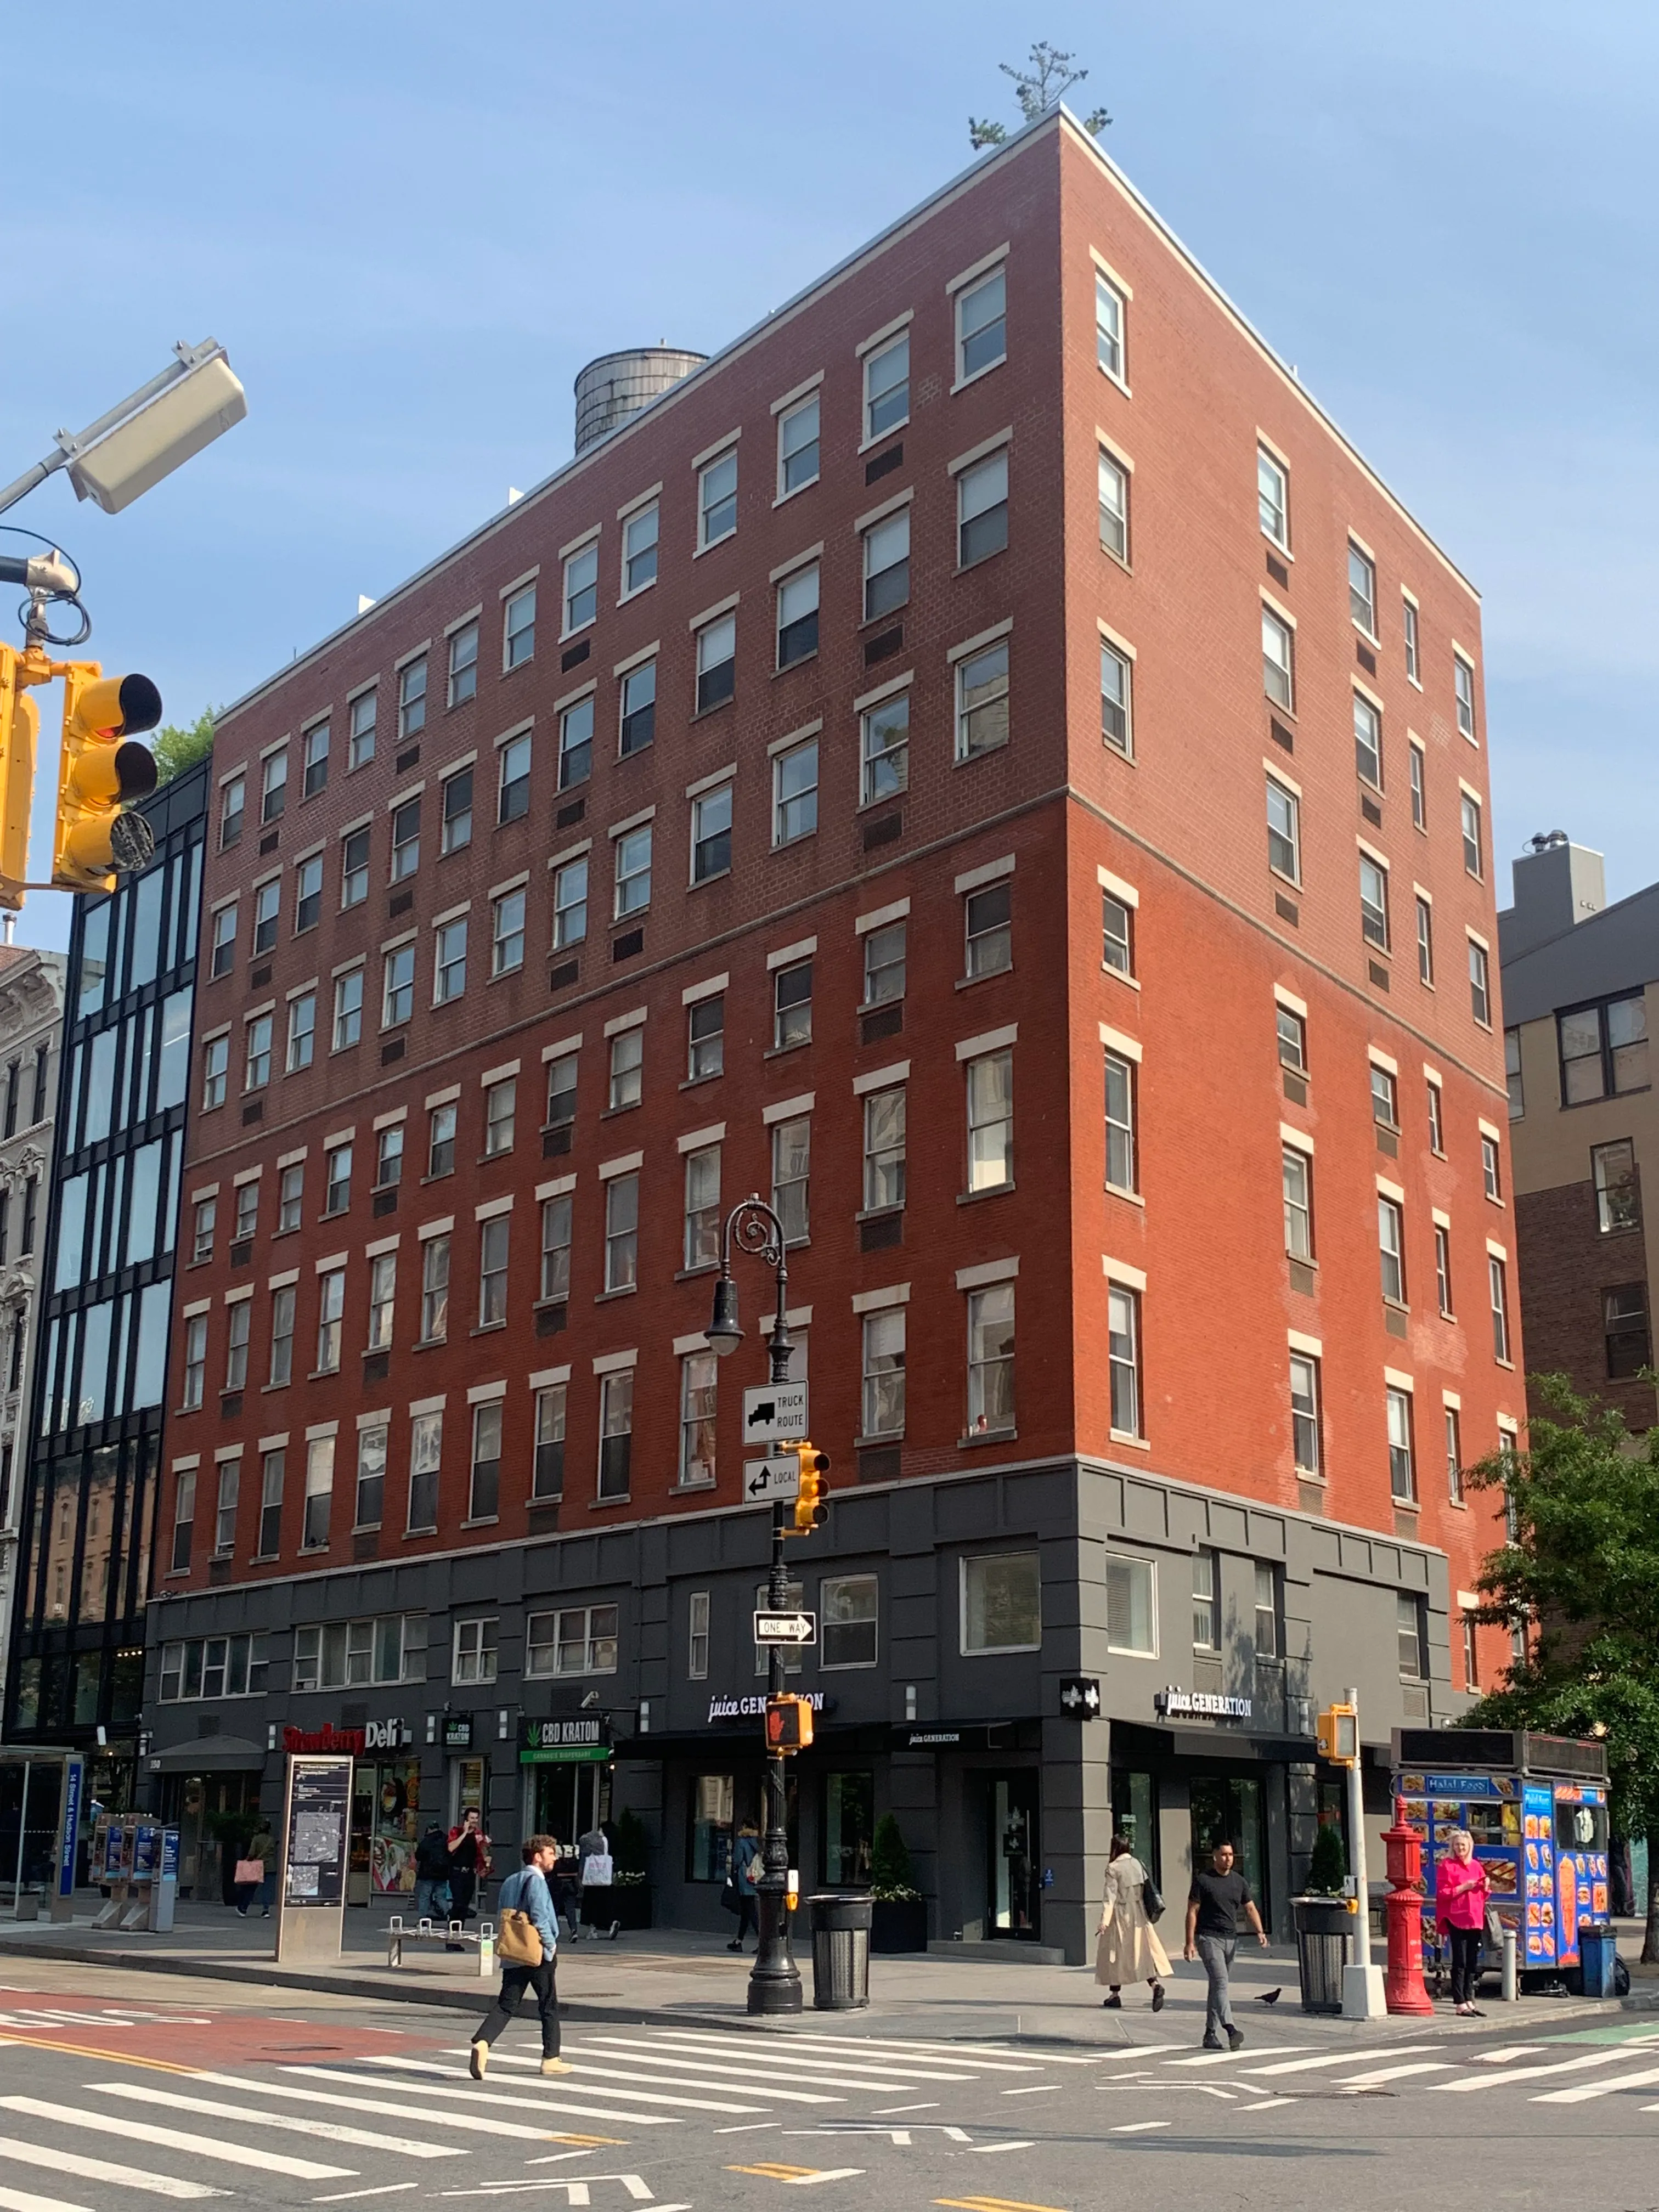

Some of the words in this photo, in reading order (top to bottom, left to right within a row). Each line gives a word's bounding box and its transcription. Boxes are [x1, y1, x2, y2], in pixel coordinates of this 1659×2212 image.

[777, 1395, 804, 1408] TRUCK
[777, 1414, 803, 1427] ROUTE
[774, 1471, 796, 1484] LOCAL
[764, 1622, 781, 1633] ONE
[789, 1622, 806, 1634] WAY
[1167, 1685, 1192, 1716] juice
[1192, 1692, 1252, 1717] GENERATION
[708, 1694, 740, 1723] juice
[365, 1718, 400, 1748] Deli
[458, 1724, 470, 1732] CBD
[542, 1723, 560, 1743] CBD
[562, 1720, 600, 1743] KRATOM
[447, 1732, 470, 1741] KRATOM
[924, 1734, 959, 1742] GENERATION
[1429, 1779, 1457, 1788] Halal
[68, 1783, 76, 1805] Street
[65, 1814, 74, 1843] Hudson
[63, 1844, 72, 1866] Street
